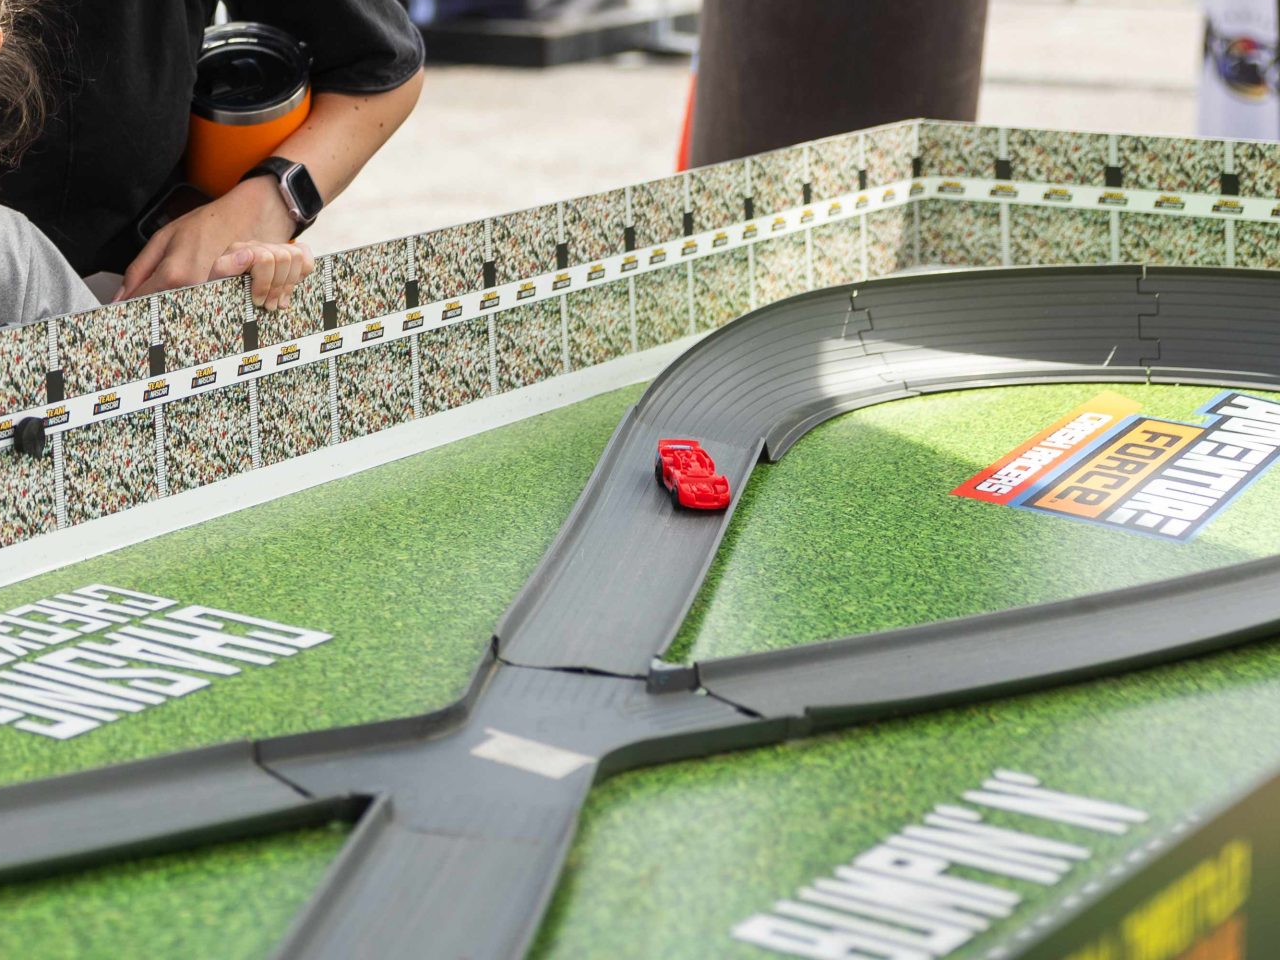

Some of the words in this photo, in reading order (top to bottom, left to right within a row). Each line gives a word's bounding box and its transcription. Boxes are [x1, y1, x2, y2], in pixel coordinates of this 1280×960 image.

[196, 366, 213, 378] TEAM
[148, 378, 166, 390] TEAM
[98, 392, 117, 404] TEAM
[46, 405, 66, 418] TEAM
[1047, 411, 1114, 450] CRASH
[975, 446, 1063, 496] RACERS
